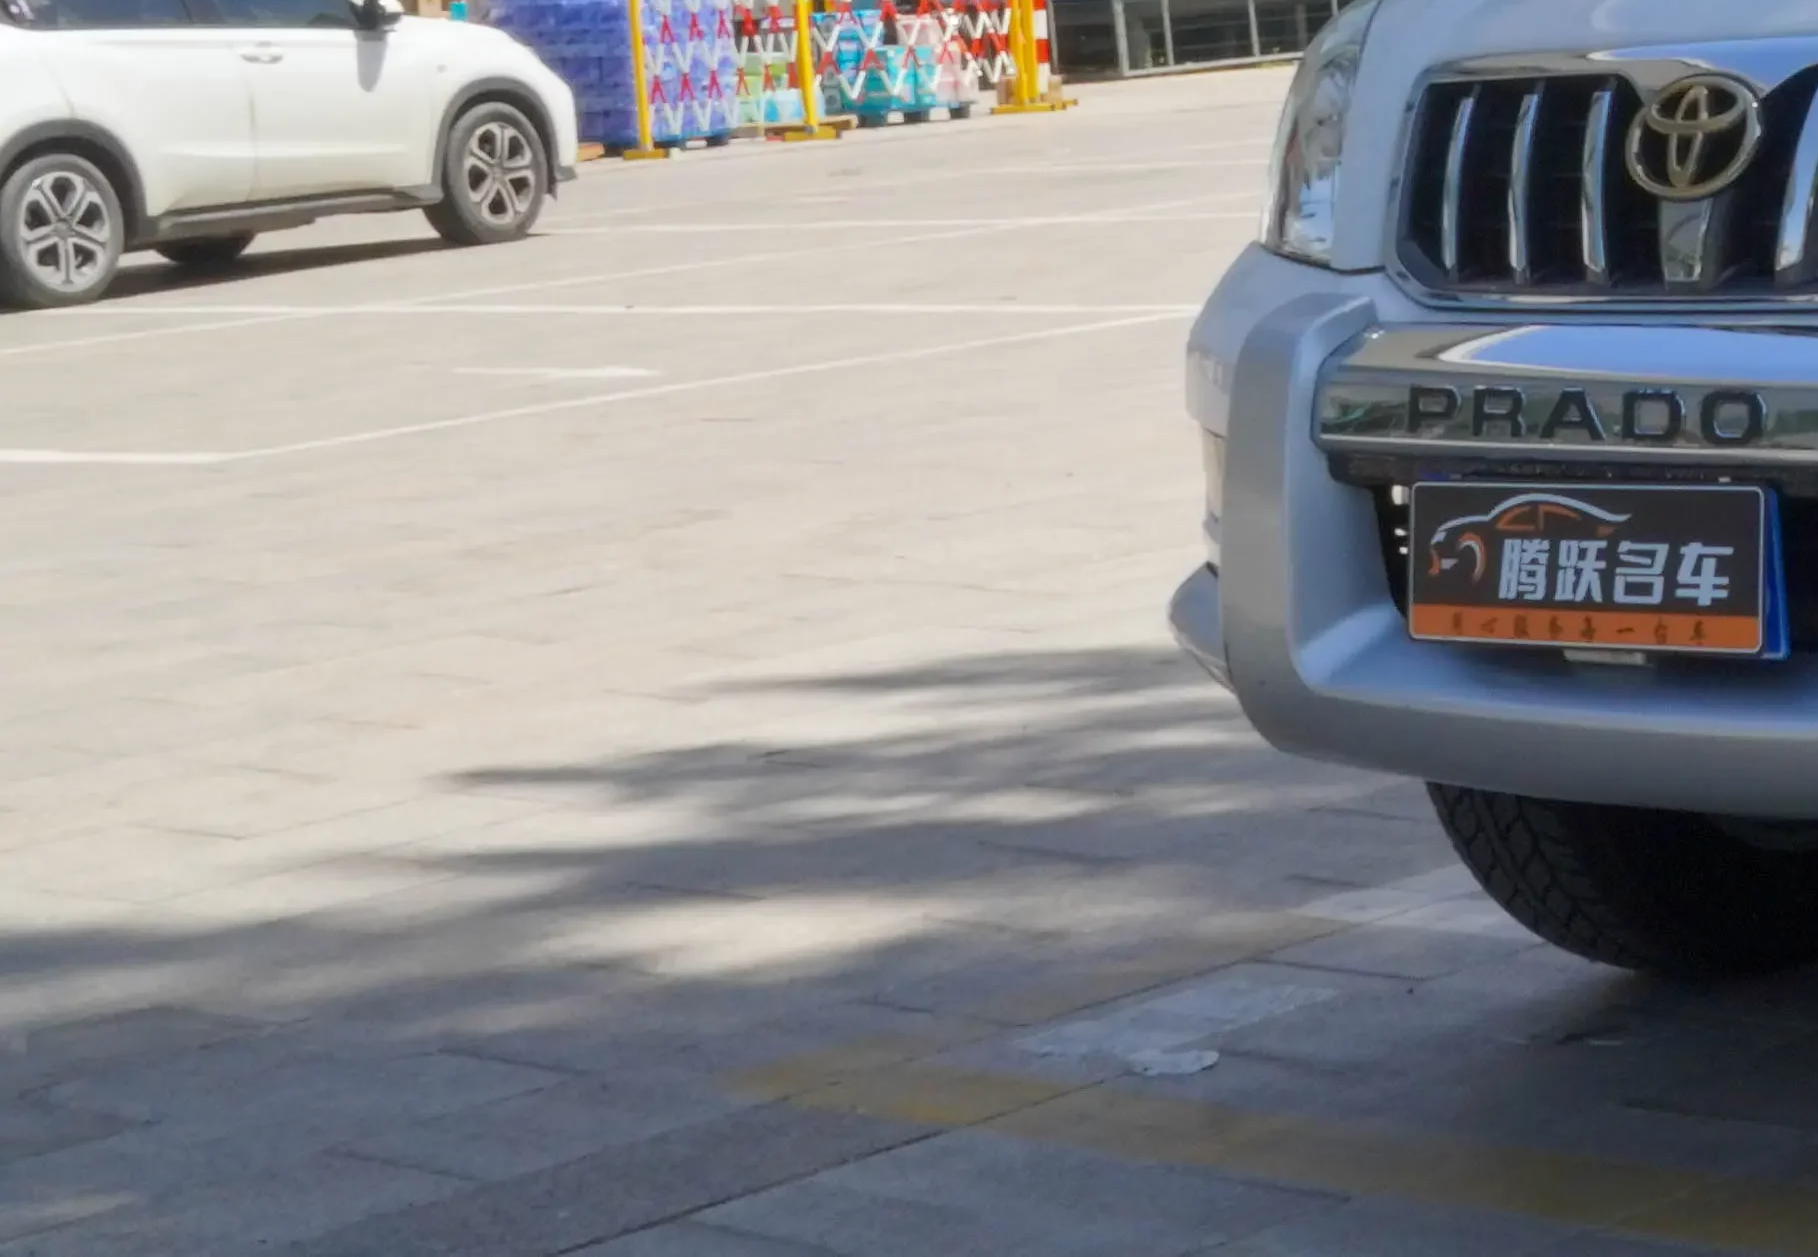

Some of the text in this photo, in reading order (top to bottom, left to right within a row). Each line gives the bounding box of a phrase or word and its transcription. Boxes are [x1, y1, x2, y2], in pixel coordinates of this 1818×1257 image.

[1408, 384, 1768, 443] PRADO
[1498, 539, 1734, 606] 腾跃名车
